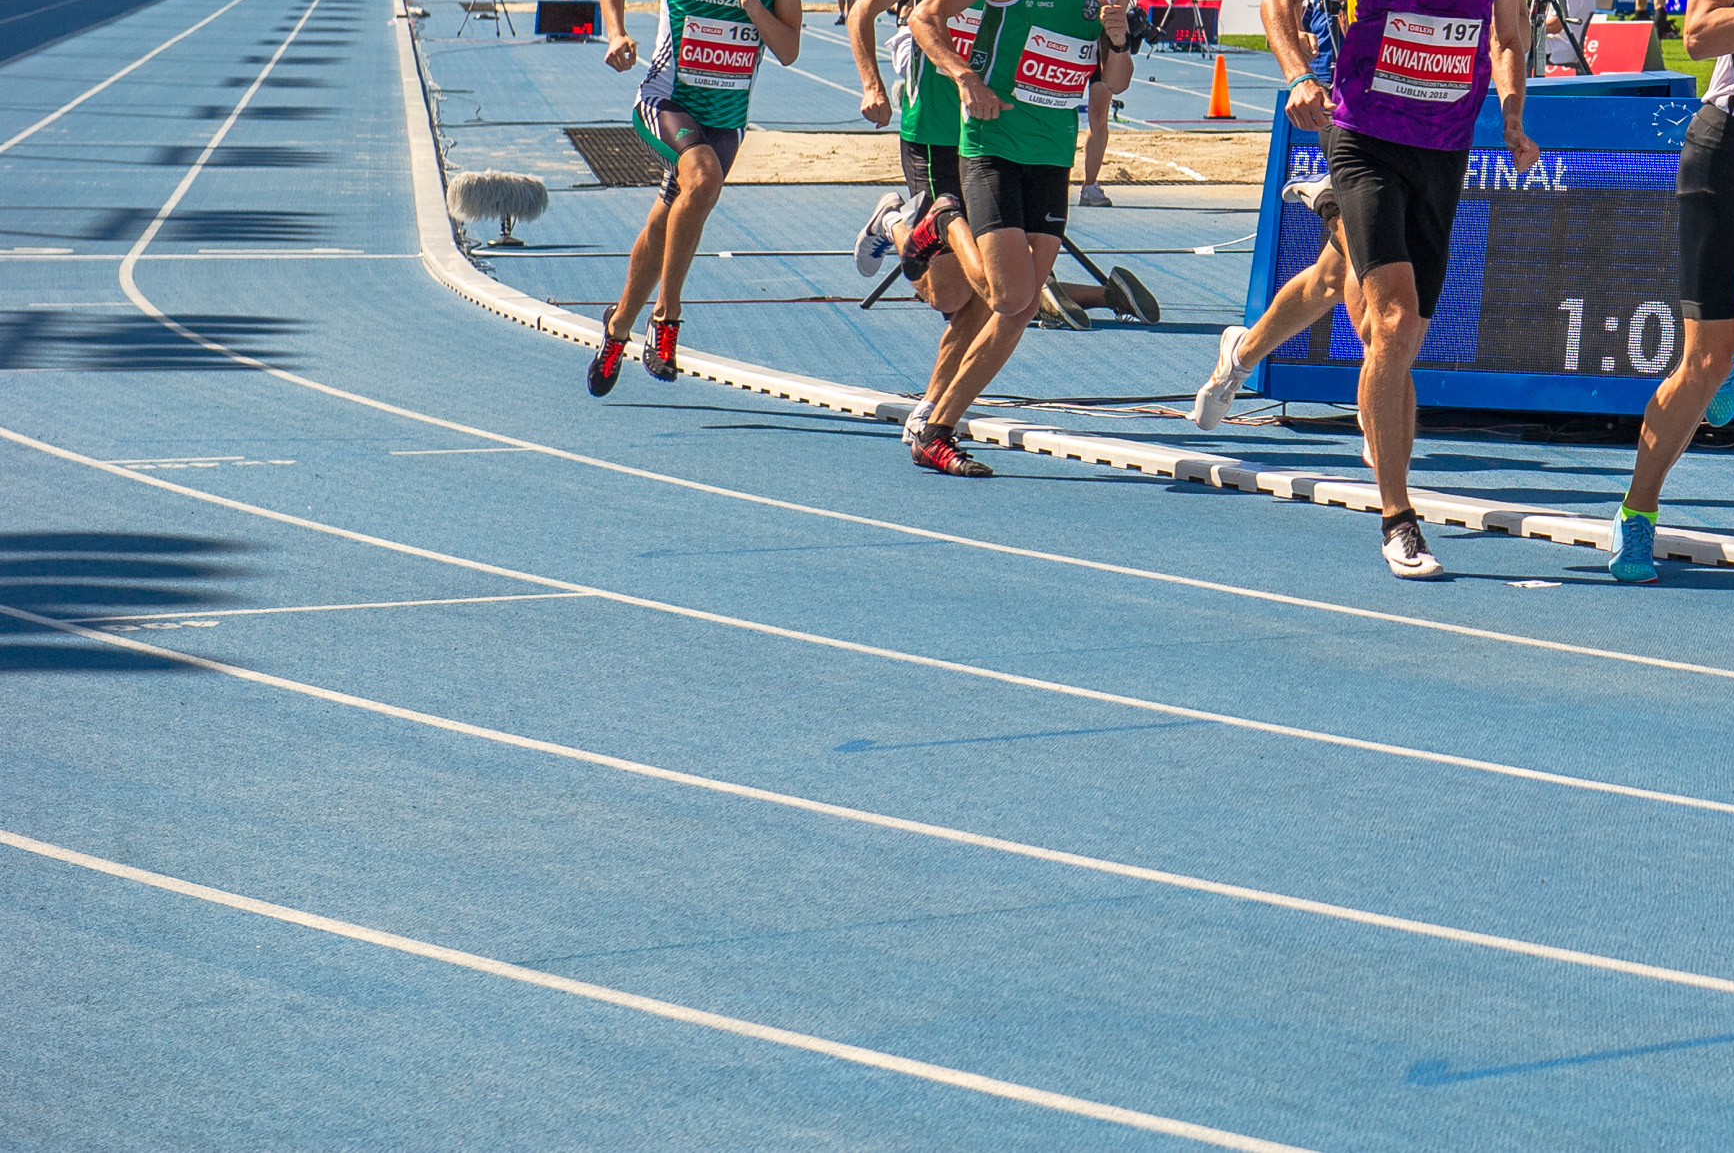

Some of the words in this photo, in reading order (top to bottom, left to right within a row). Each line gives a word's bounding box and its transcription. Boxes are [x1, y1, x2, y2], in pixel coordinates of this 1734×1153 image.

[729, 26, 760, 41] 163
[1409, 25, 1433, 35] ORLEN
[1442, 23, 1480, 41] 197
[682, 45, 755, 67] GADOMSKI
[1078, 44, 1094, 60] 91
[1381, 44, 1472, 74] KWIATKOWSKI
[1022, 59, 1091, 85] OLESZEK
[694, 77, 720, 86] LUBLIN
[1028, 94, 1053, 106] LUBLIN
[1395, 85, 1428, 99] LUBLIN
[1428, 91, 1449, 99] 2018
[1463, 154, 1569, 192] FINAŁ
